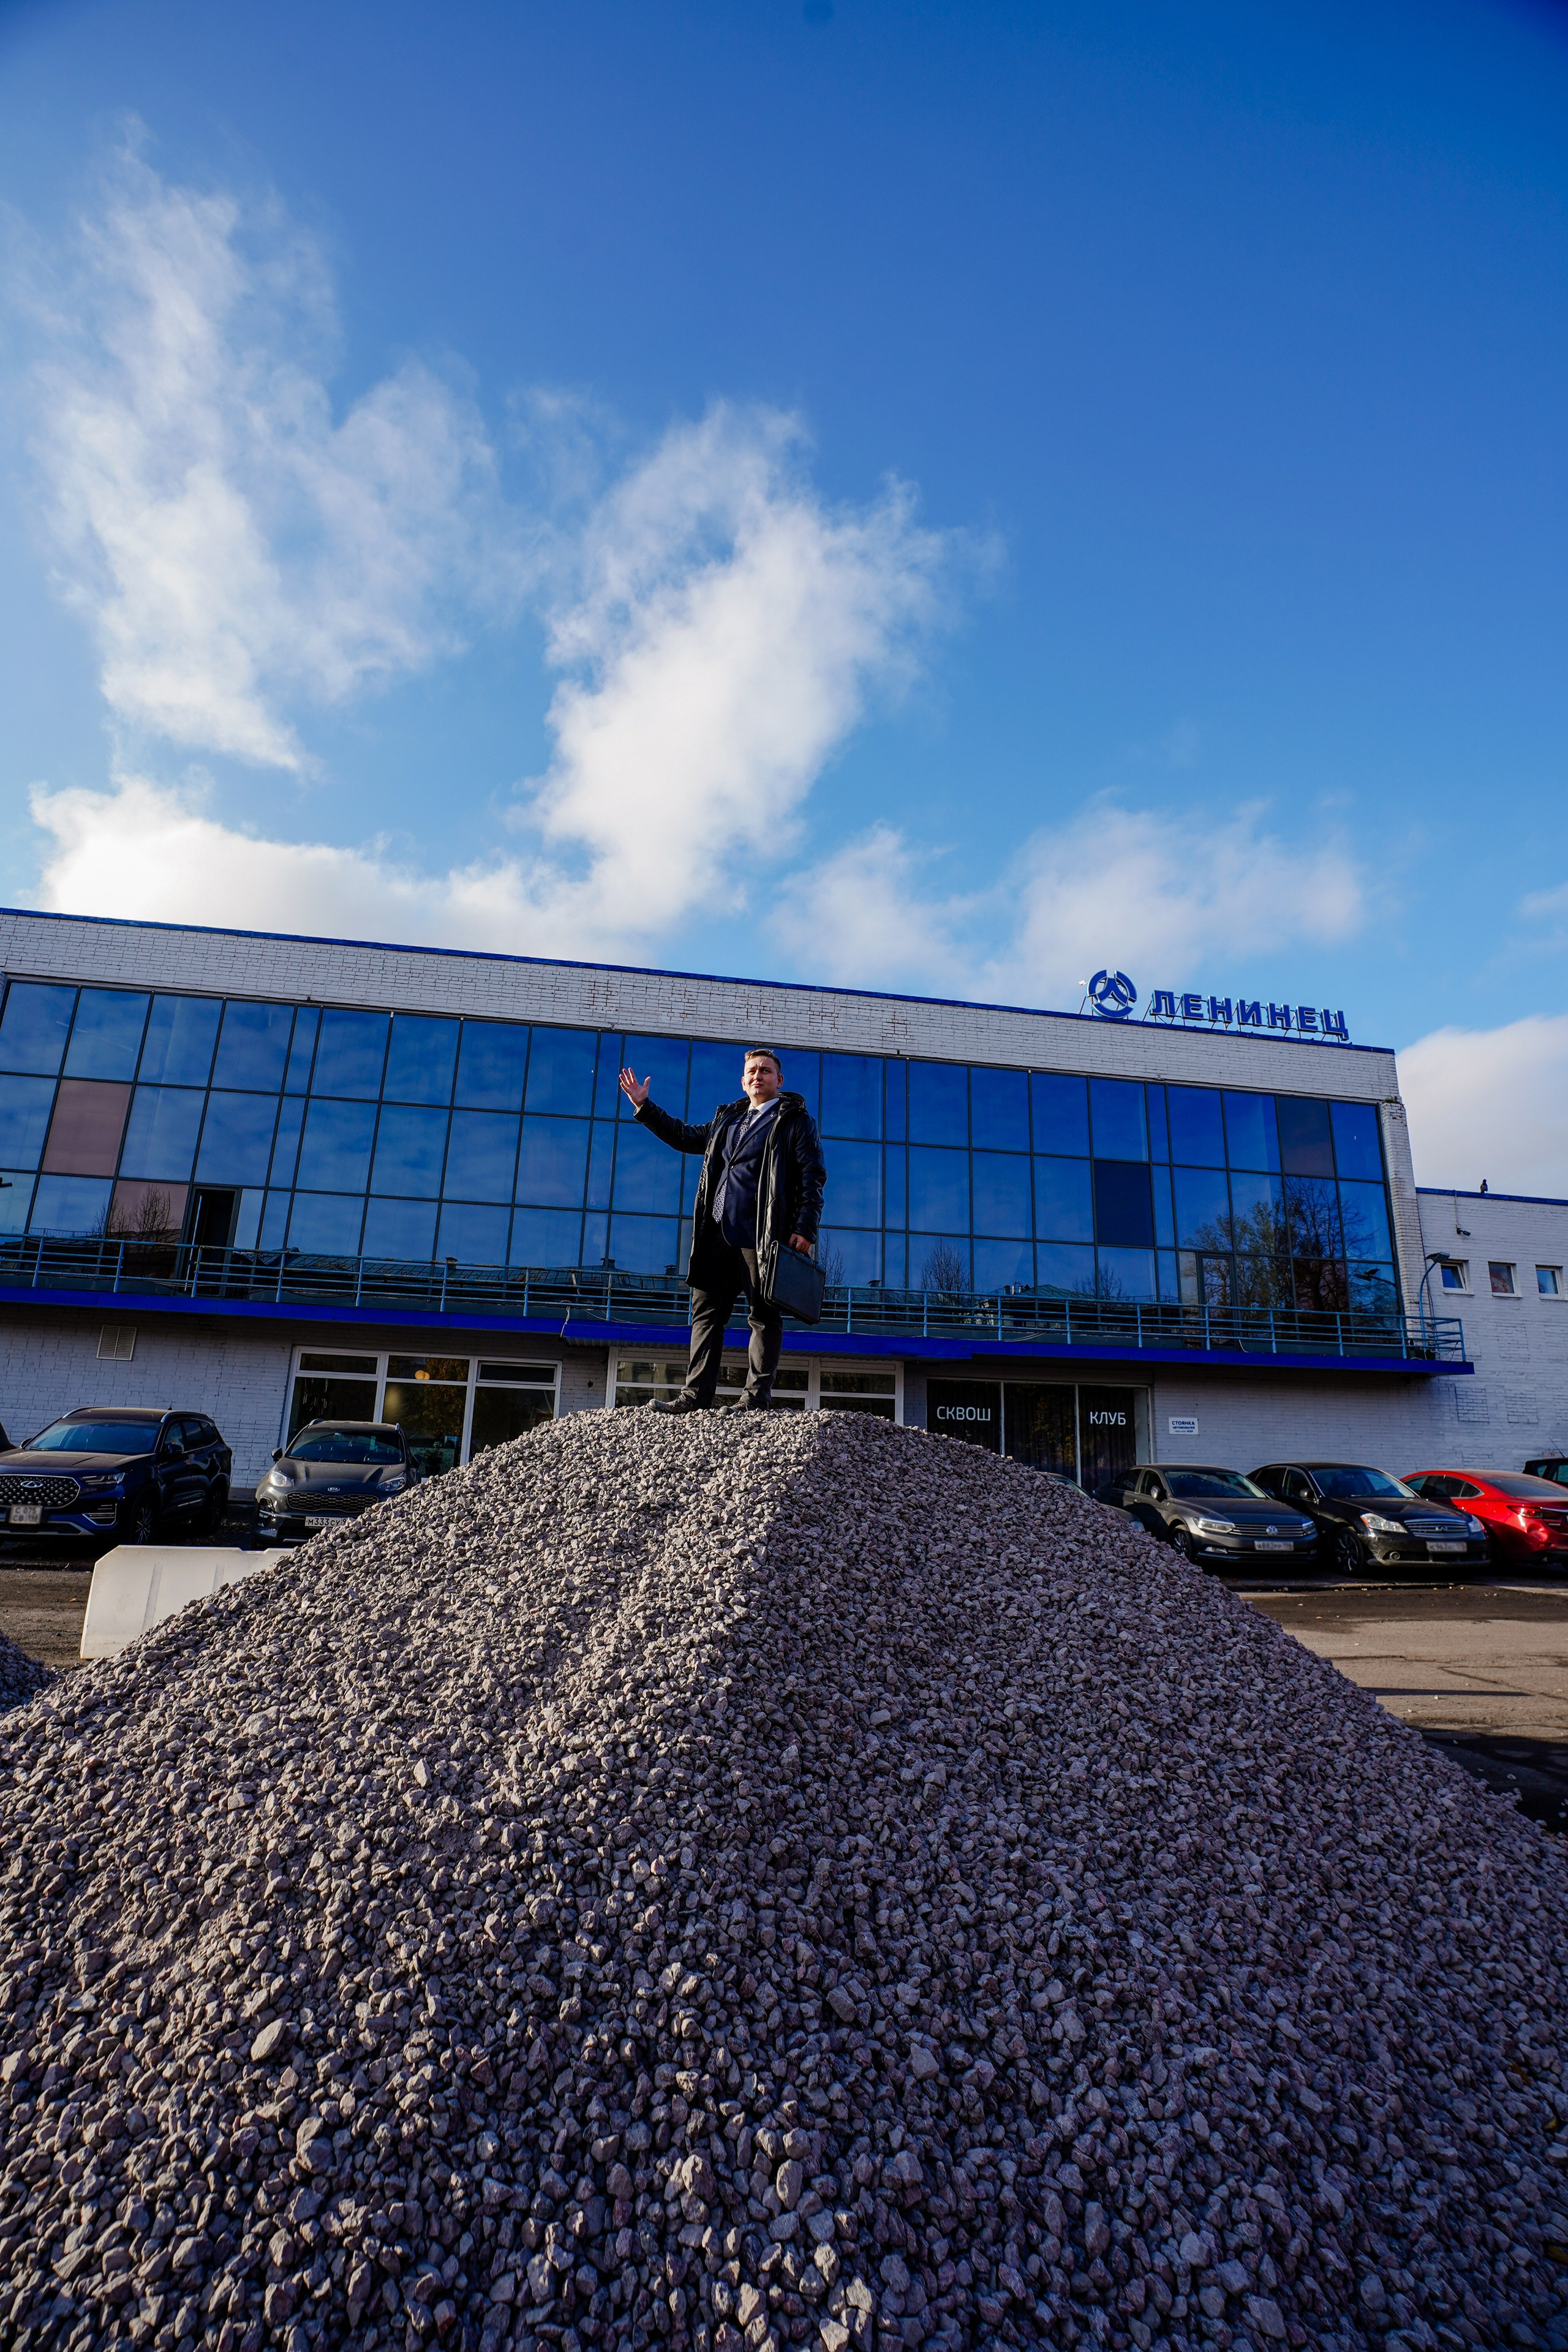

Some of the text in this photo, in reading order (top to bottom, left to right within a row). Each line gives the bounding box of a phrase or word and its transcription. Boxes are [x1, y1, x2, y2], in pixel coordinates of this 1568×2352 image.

[1150, 989, 1349, 1041] ЛЕНИНЕЦ
[937, 1406, 1126, 1426] СКВОШ КЛУБ
